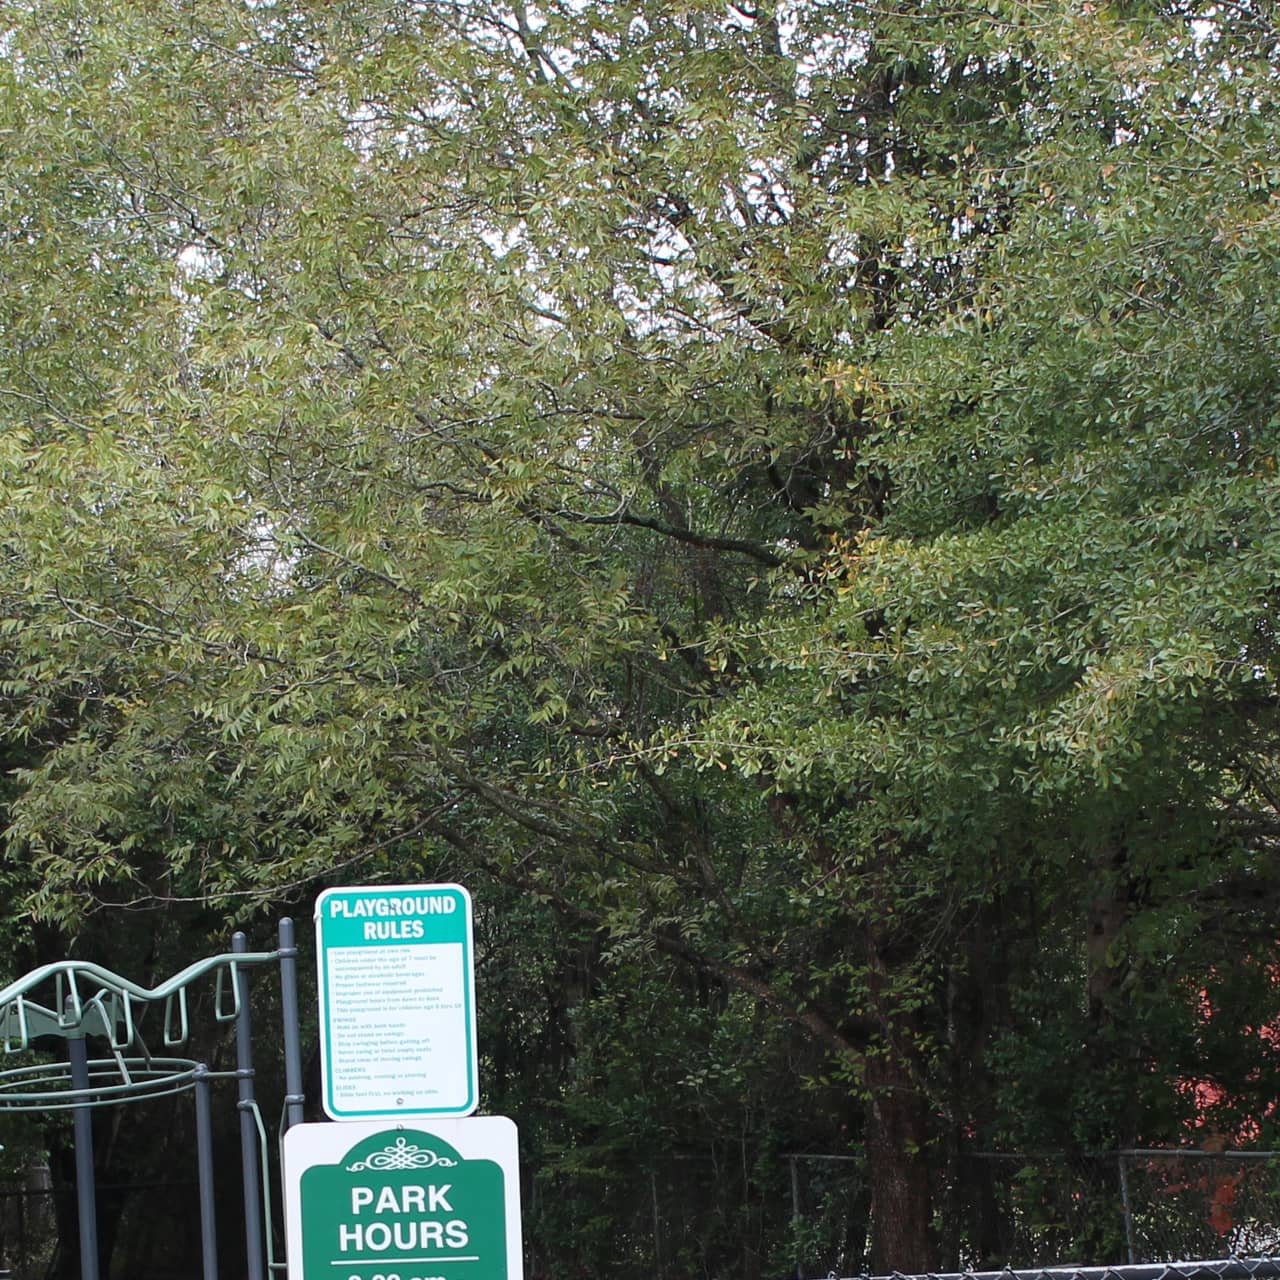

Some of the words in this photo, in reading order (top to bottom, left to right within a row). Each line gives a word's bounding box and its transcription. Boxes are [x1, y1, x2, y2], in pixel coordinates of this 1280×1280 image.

[331, 896, 456, 917] PLAYGROUND
[364, 921, 424, 939] RULES
[351, 1184, 454, 1214] PARK
[339, 1219, 469, 1251] HOURS
